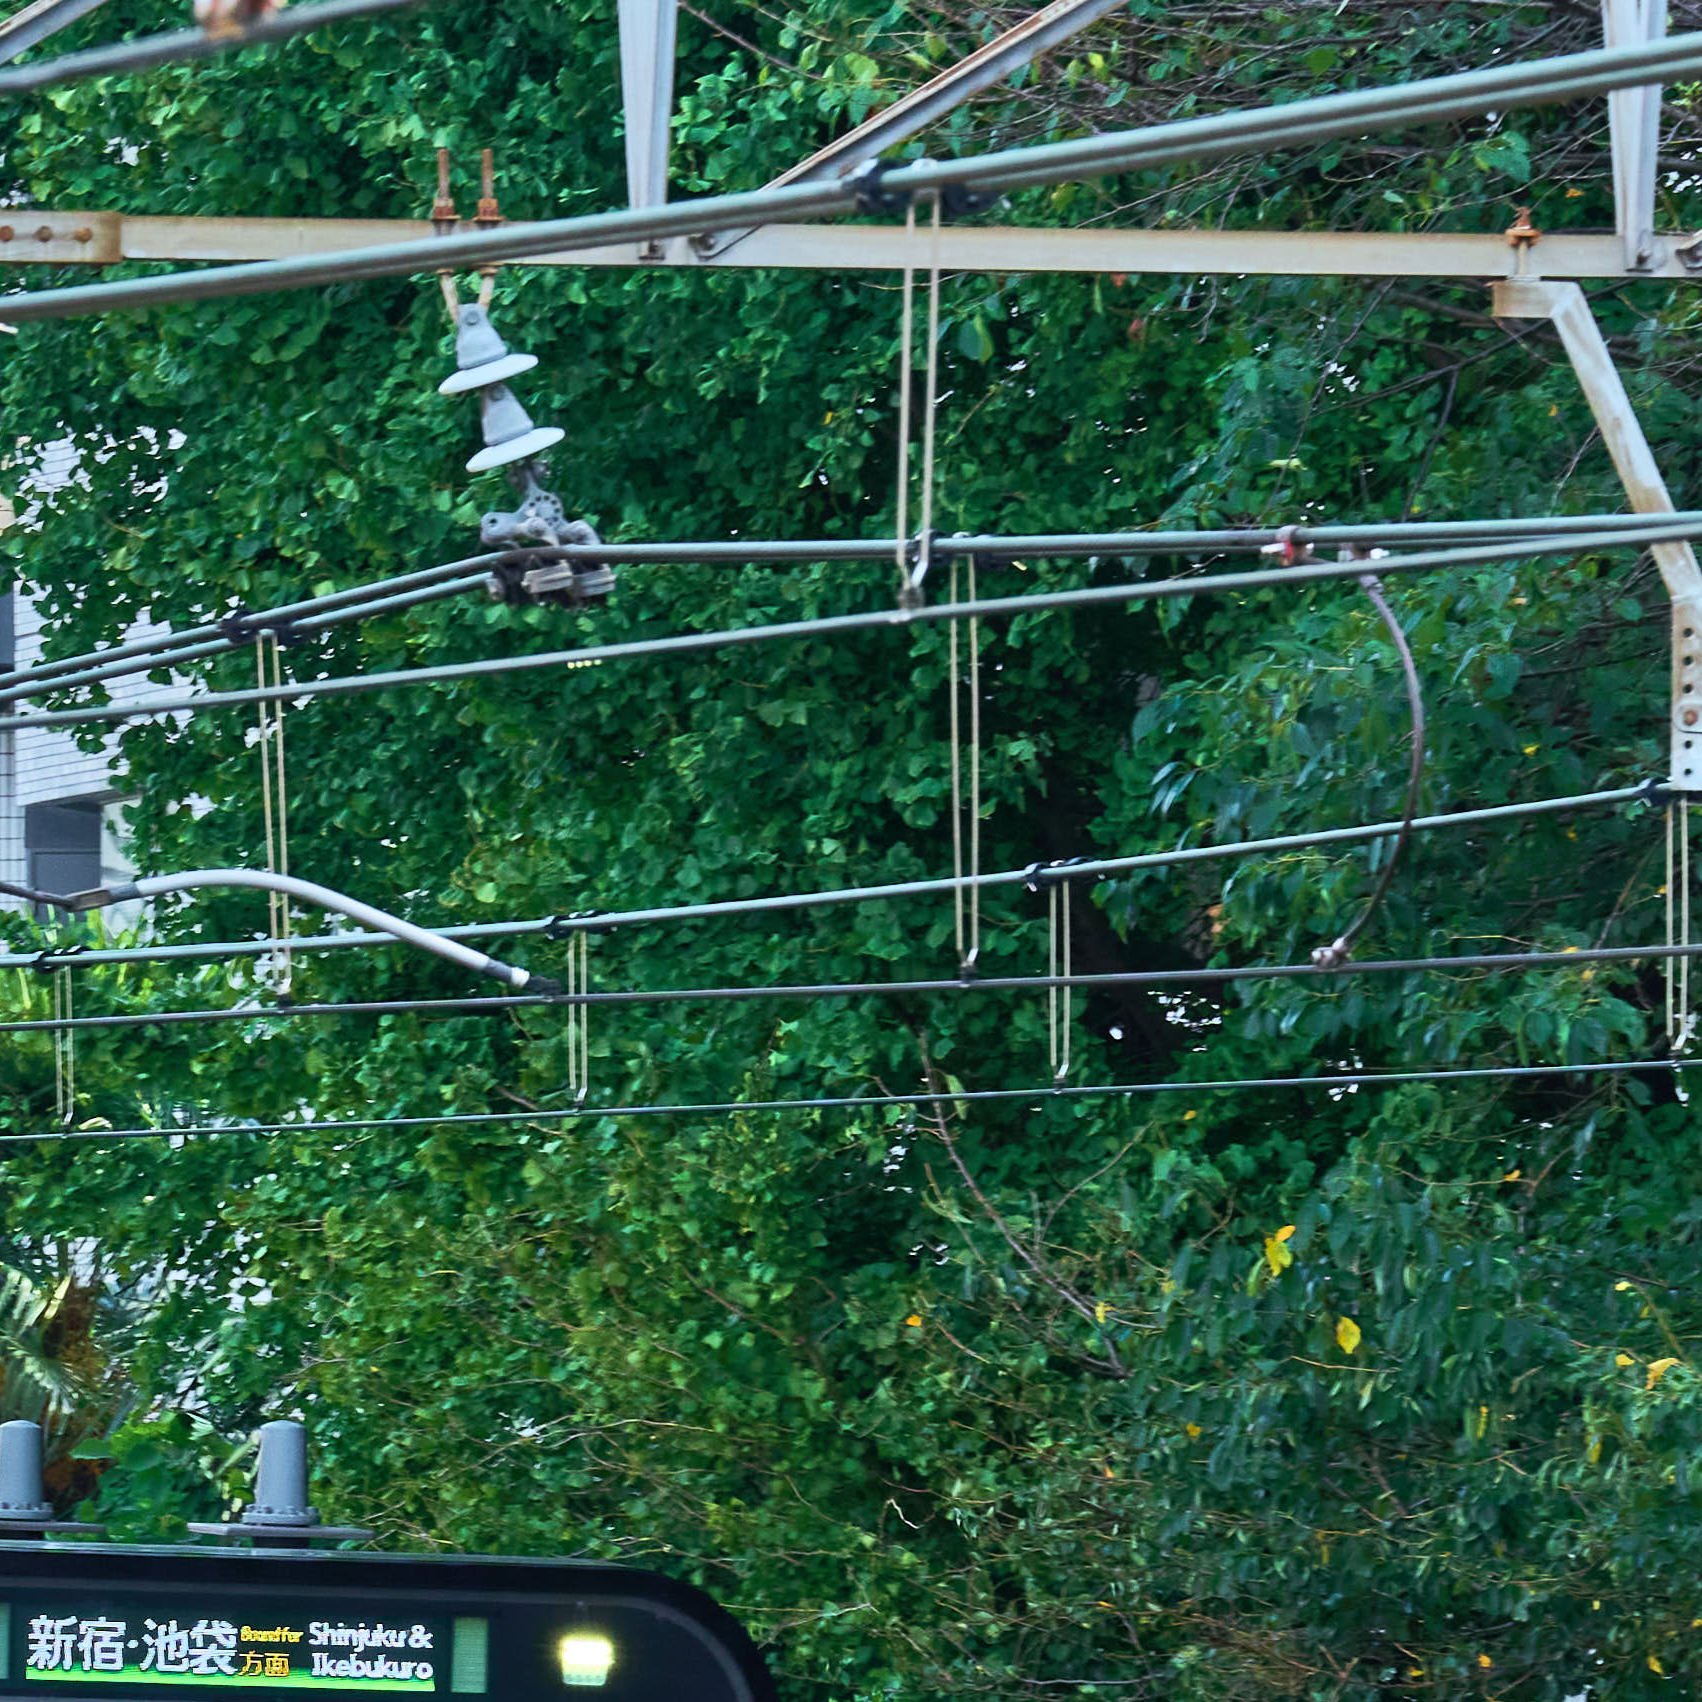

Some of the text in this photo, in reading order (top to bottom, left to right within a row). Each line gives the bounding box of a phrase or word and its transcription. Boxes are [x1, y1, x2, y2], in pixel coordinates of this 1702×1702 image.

[308, 1621, 434, 1654] Shinjuku &
[238, 1650, 290, 1677] 方面
[311, 1652, 434, 1681] Ikebukuro
